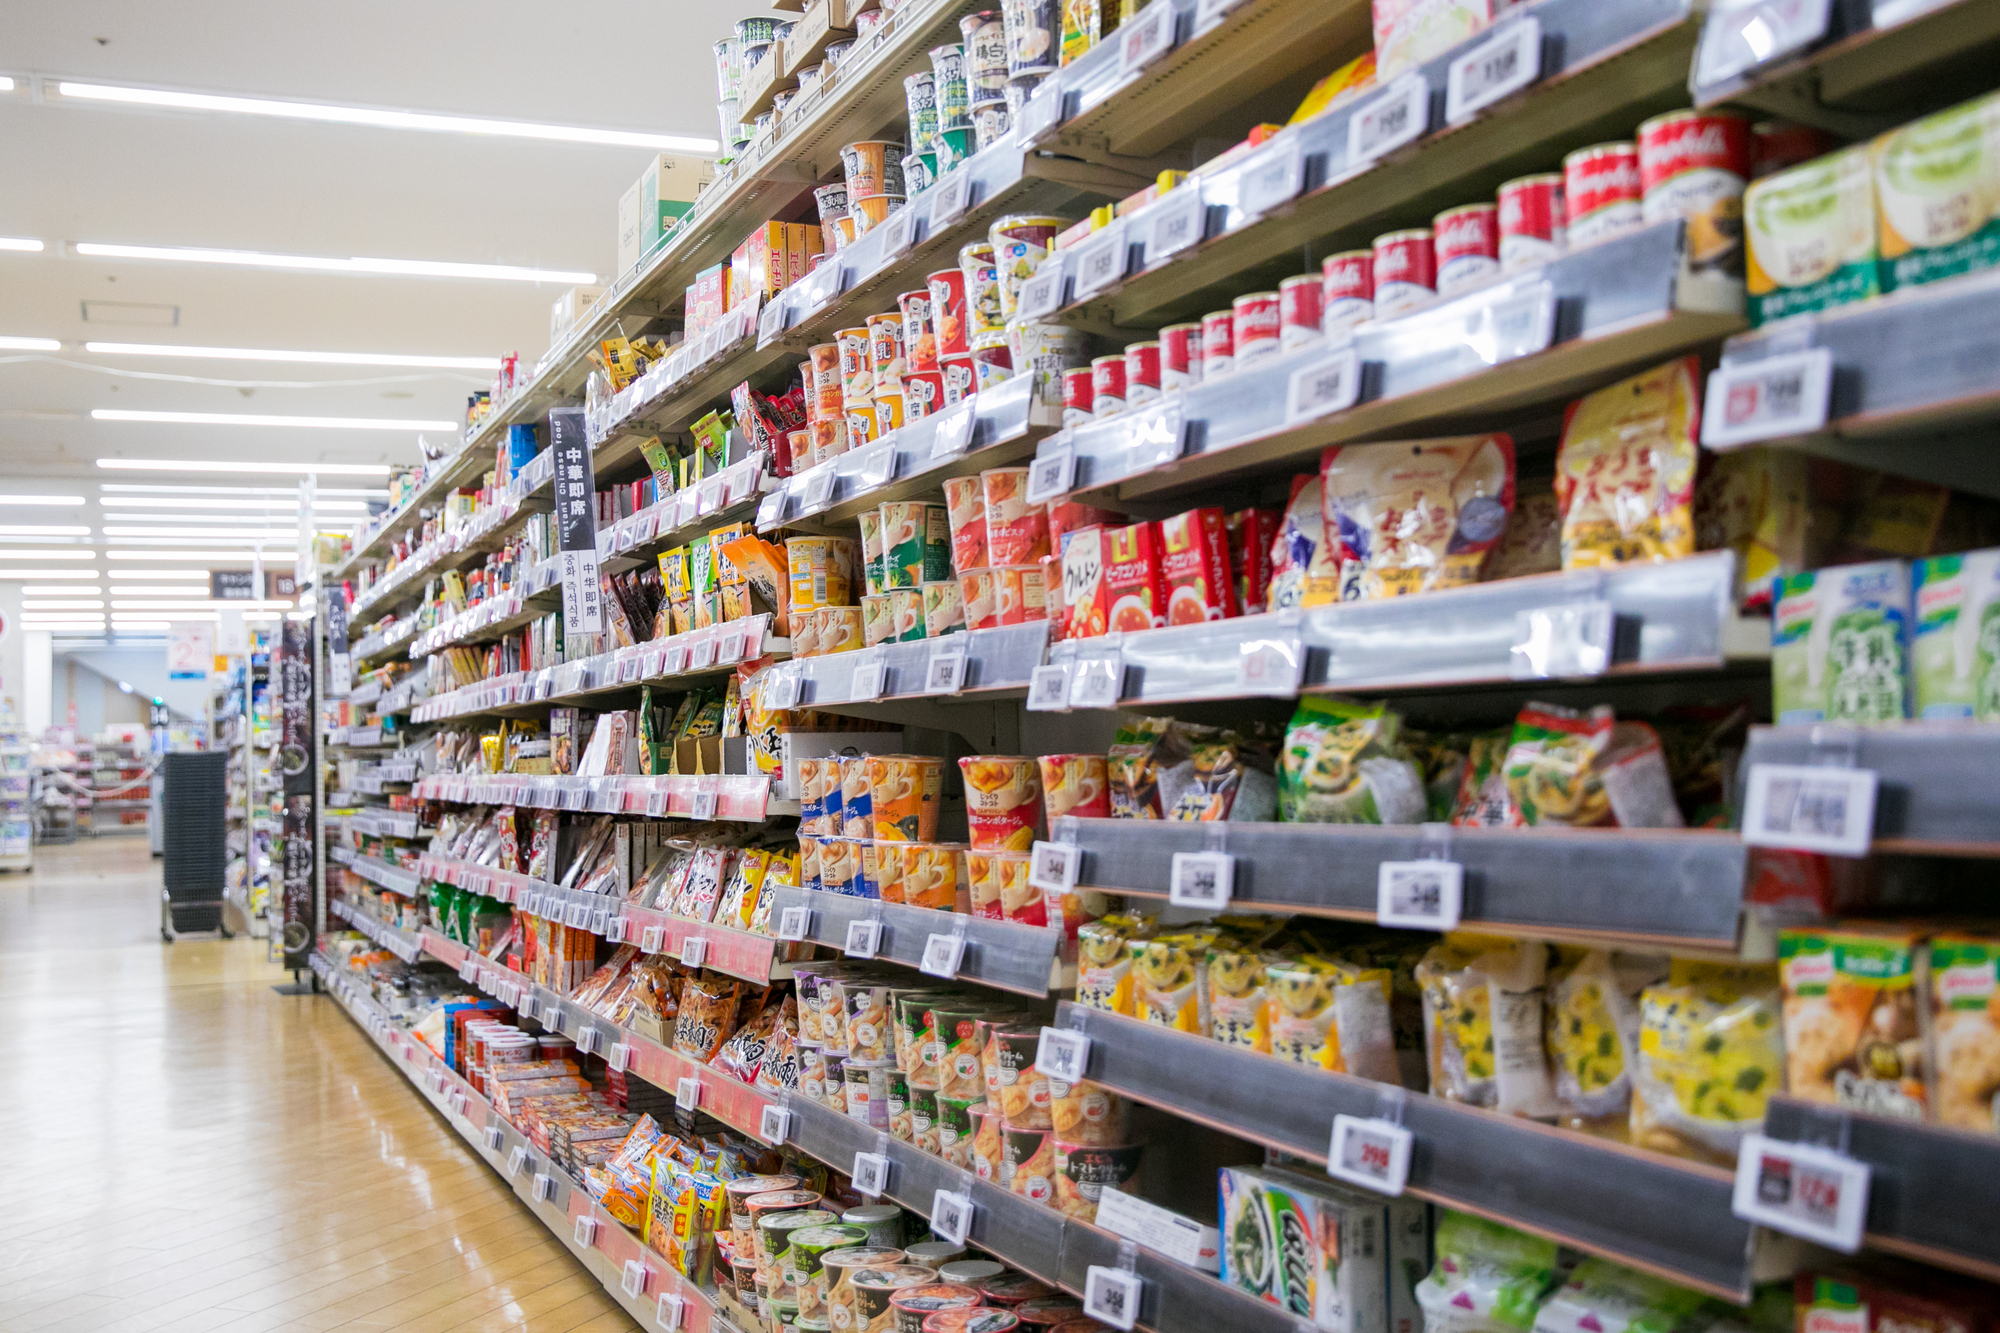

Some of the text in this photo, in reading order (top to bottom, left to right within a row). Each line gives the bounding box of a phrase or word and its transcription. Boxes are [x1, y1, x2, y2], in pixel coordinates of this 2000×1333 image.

[976, 44, 1006, 62] 鶏白
[771, 249, 782, 287] エビチリ
[789, 251, 799, 284] エビチ
[698, 275, 718, 298] 酢豚
[554, 420, 571, 543] food Chinese Instant
[566, 447, 586, 516] 中華即席
[564, 554, 580, 628] 중화 즉석식품
[583, 562, 598, 617] 中华即席
[1065, 562, 1100, 597] クルトン
[940, 667, 953, 679] 138
[865, 1167, 876, 1182] 148
[675, 1216, 686, 1234] 中辛
[946, 1209, 959, 1228] 148
